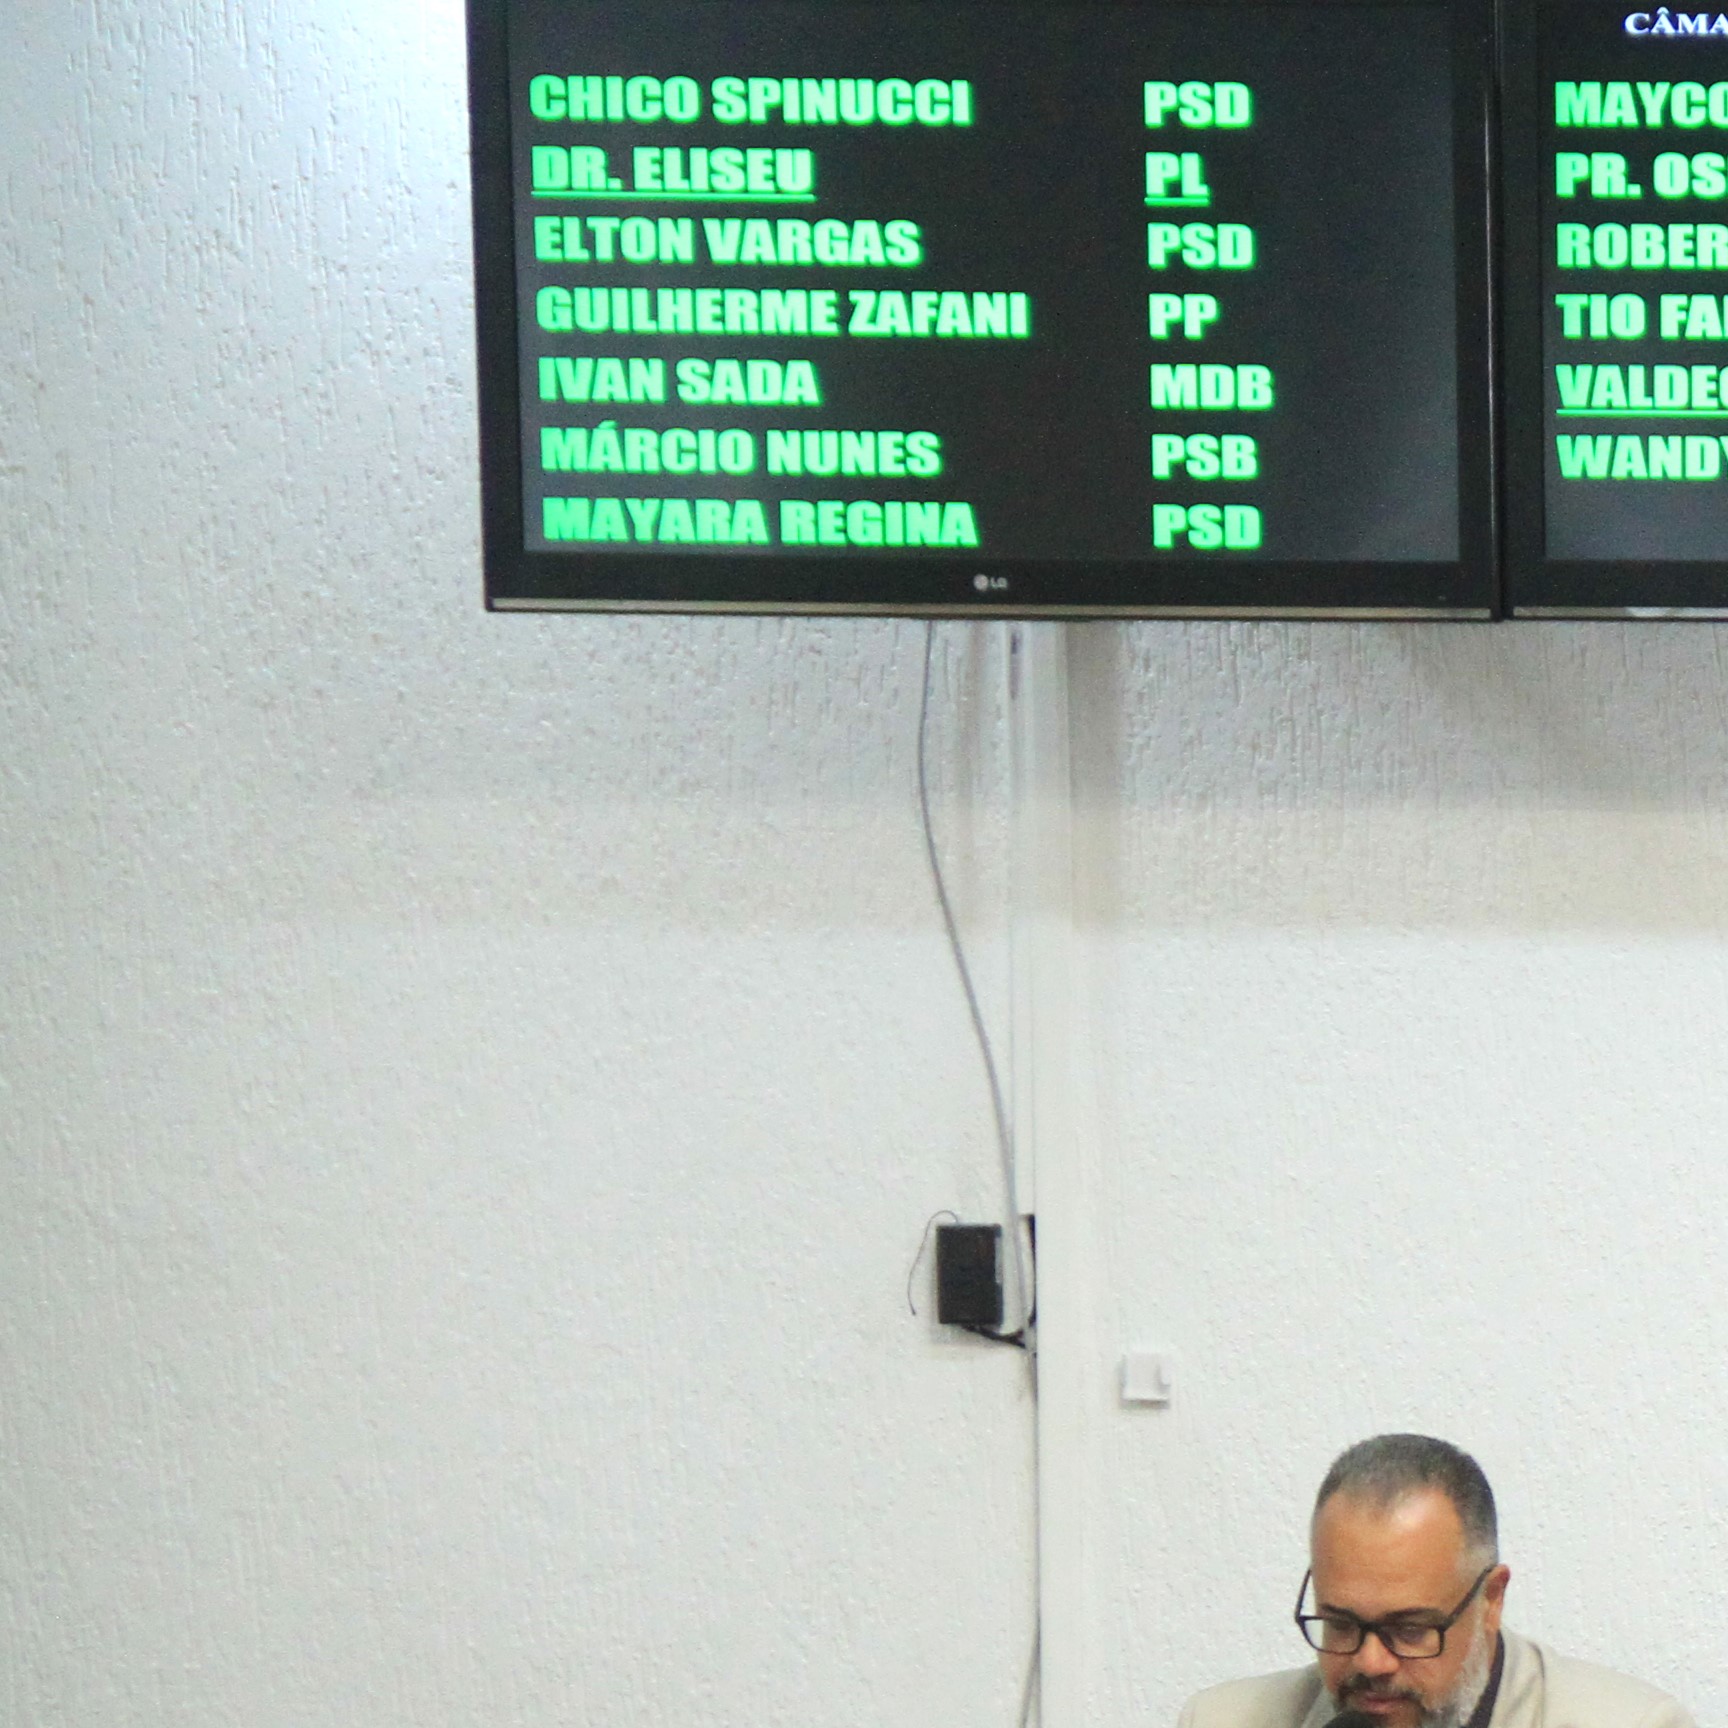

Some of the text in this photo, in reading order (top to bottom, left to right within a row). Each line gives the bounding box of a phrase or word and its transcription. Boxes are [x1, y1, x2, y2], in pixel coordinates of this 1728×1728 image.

[529, 74, 973, 127] CHICO SPINUCCI
[1143, 81, 1253, 129] PSD
[531, 145, 815, 192] DR. ELISEU
[1145, 151, 1211, 197] PL
[1555, 152, 1643, 200] PR.
[534, 215, 923, 268] ELTON VARGAS
[1147, 222, 1256, 270] PSD
[536, 286, 1031, 339] GUILHERME ZAFANI
[1148, 293, 1220, 341] PP
[1555, 293, 1647, 341] TIO
[538, 357, 822, 406] IVAN SADA
[1150, 363, 1275, 411] MDB
[540, 420, 943, 478] MÁRCIO NUNES
[1151, 433, 1259, 481] PSB
[542, 497, 980, 548] MAYARA REGINA
[1152, 503, 1263, 550] PSD
